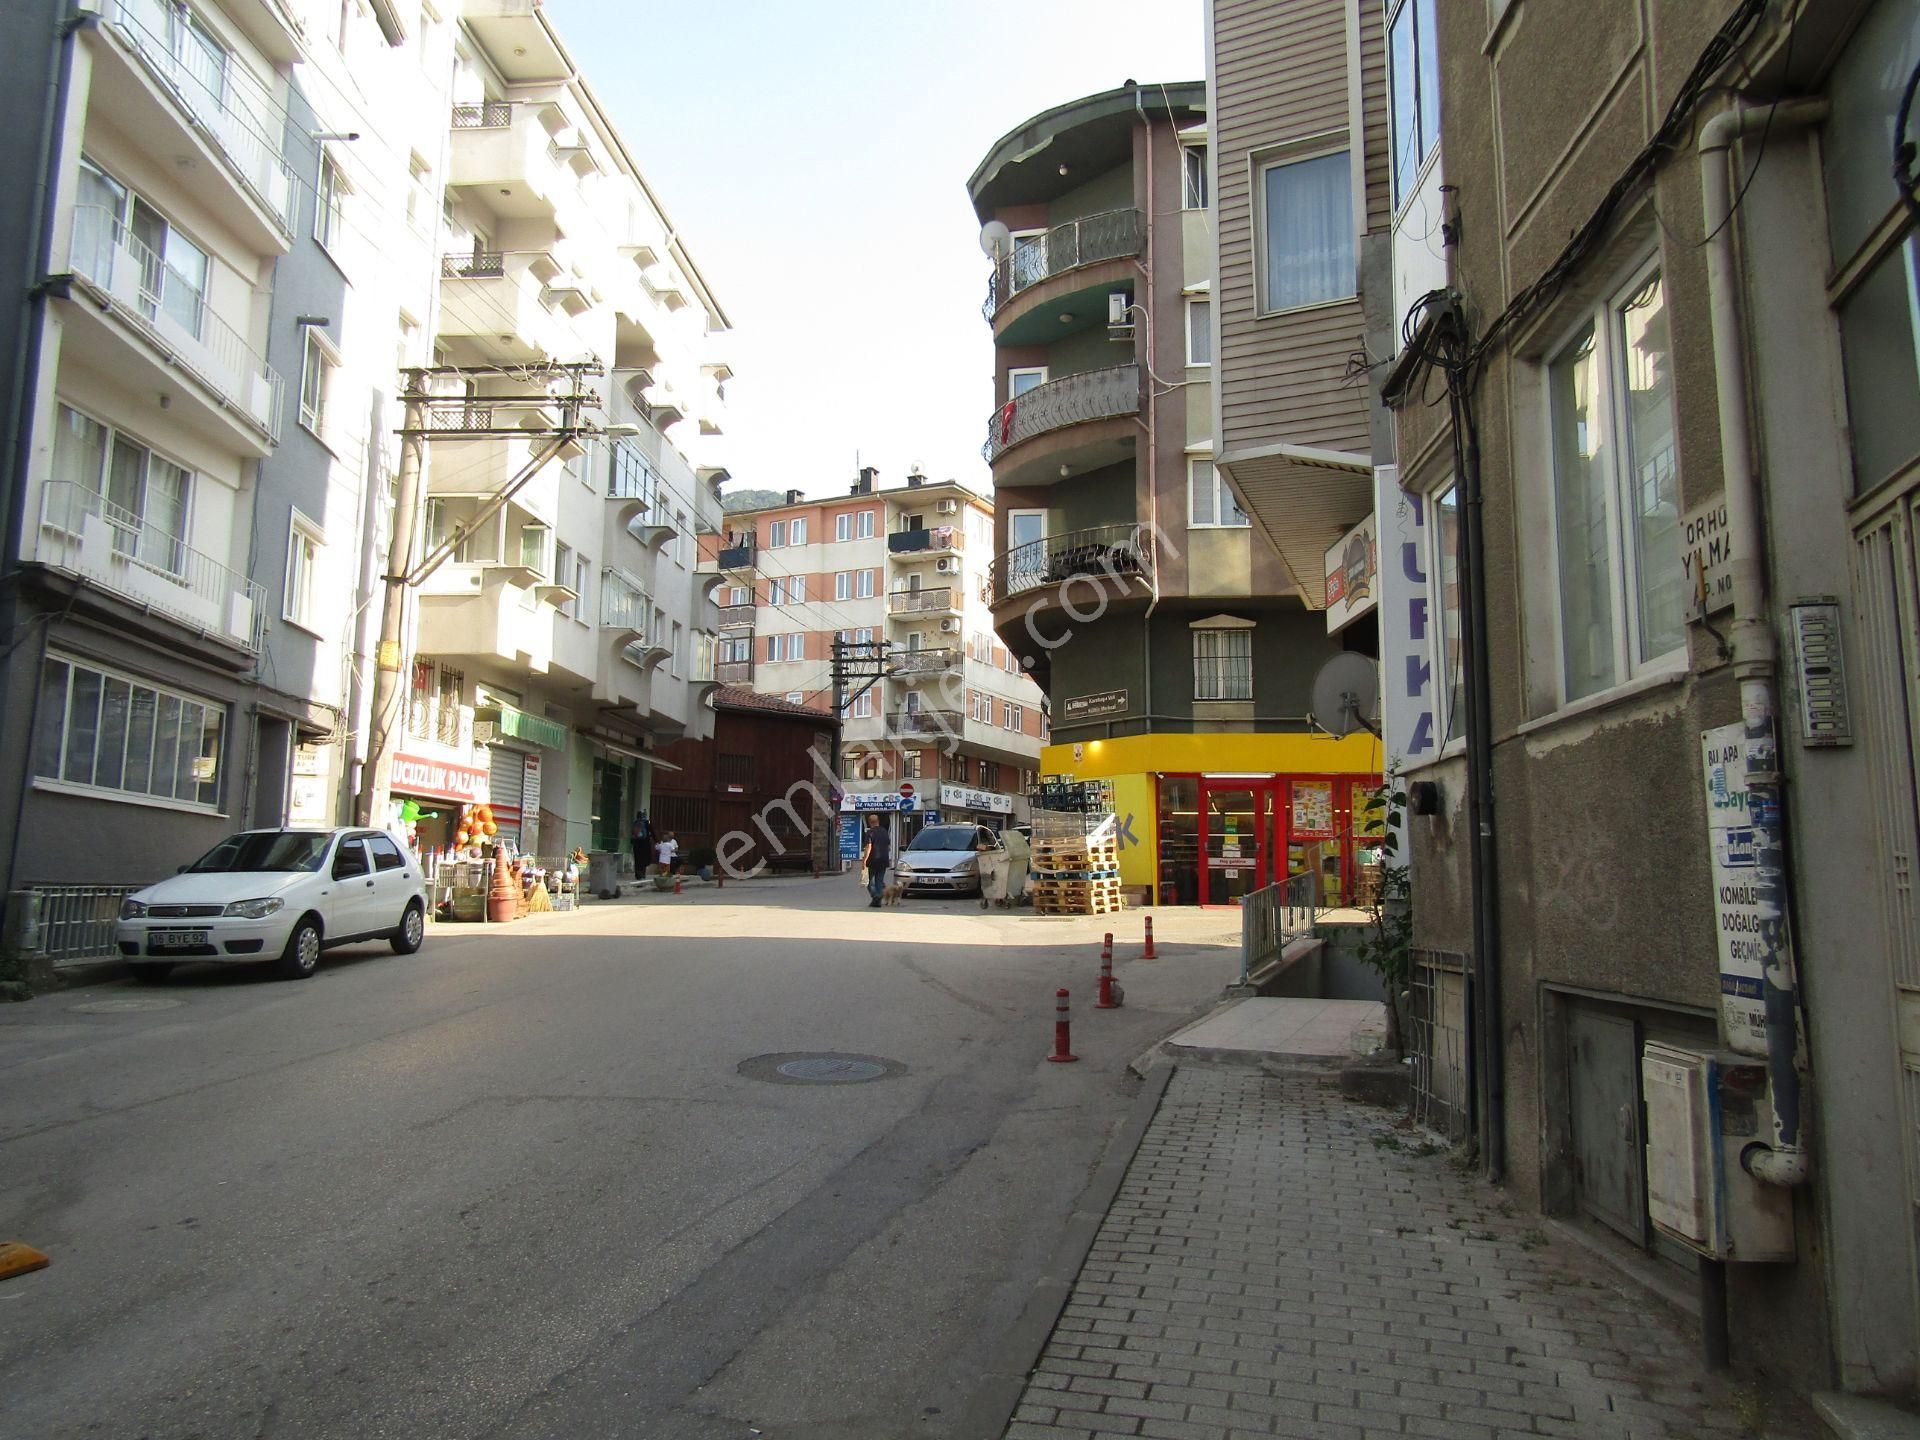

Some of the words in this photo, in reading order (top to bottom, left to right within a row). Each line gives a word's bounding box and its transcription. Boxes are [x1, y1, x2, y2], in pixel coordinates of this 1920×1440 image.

[1723, 744, 1739, 764] APA
[391, 759, 448, 791] UCUZLUK
[1719, 881, 1758, 906] KOMBİLE
[1722, 910, 1760, 934] DOĞALG
[1748, 1008, 1766, 1030] MÜH
